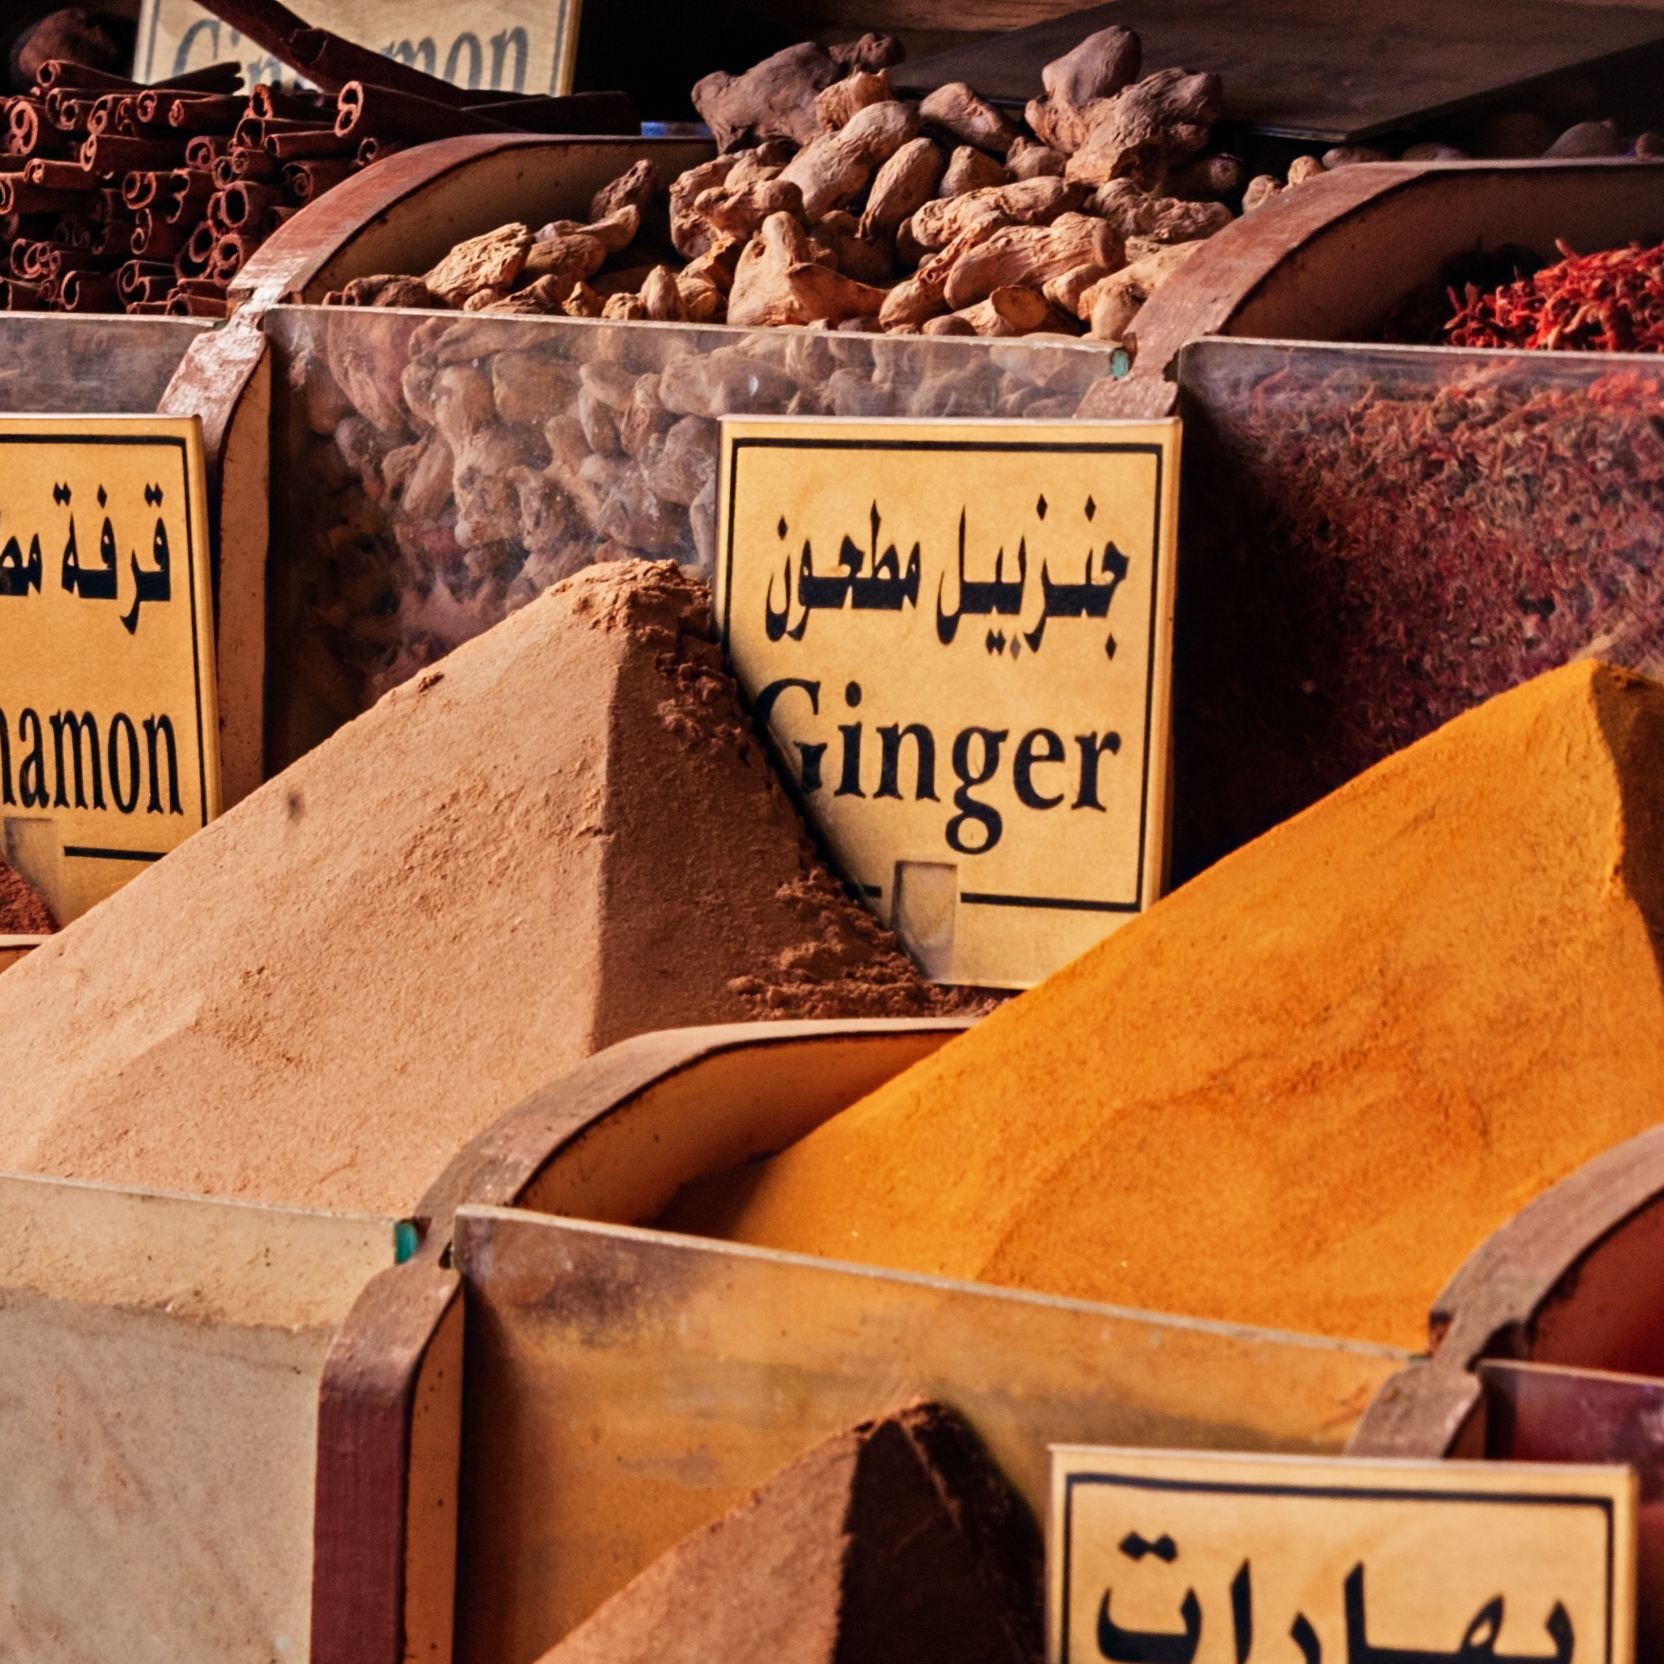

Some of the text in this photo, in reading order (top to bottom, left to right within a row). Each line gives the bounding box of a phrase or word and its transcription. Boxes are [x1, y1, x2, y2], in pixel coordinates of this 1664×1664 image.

[52, 481, 171, 635] قرفة
[765, 501, 922, 645] مطحون
[753, 678, 1120, 855] Ginger
